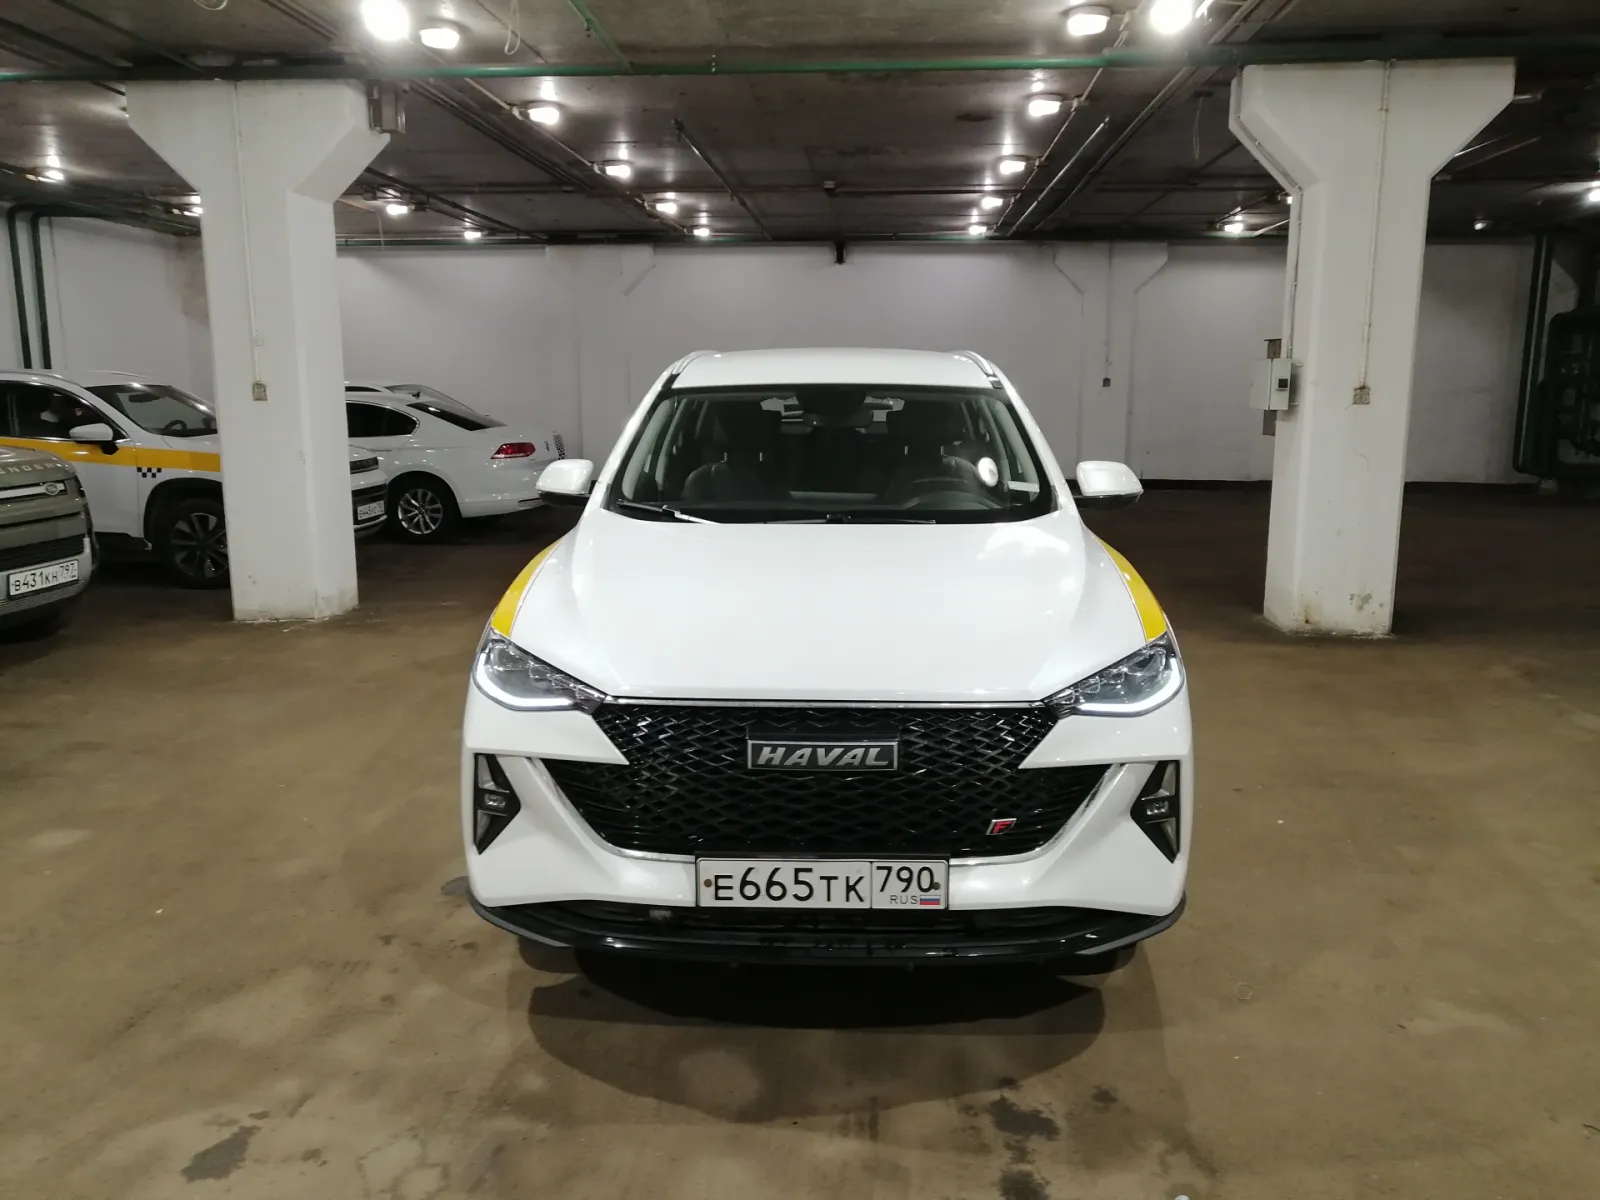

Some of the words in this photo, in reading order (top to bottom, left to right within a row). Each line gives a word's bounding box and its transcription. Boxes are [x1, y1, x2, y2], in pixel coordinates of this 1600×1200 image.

[757, 746, 889, 766] HAVAL
[714, 867, 865, 902] Е665ТК
[876, 866, 935, 893] 790
[890, 895, 918, 905] RUS
